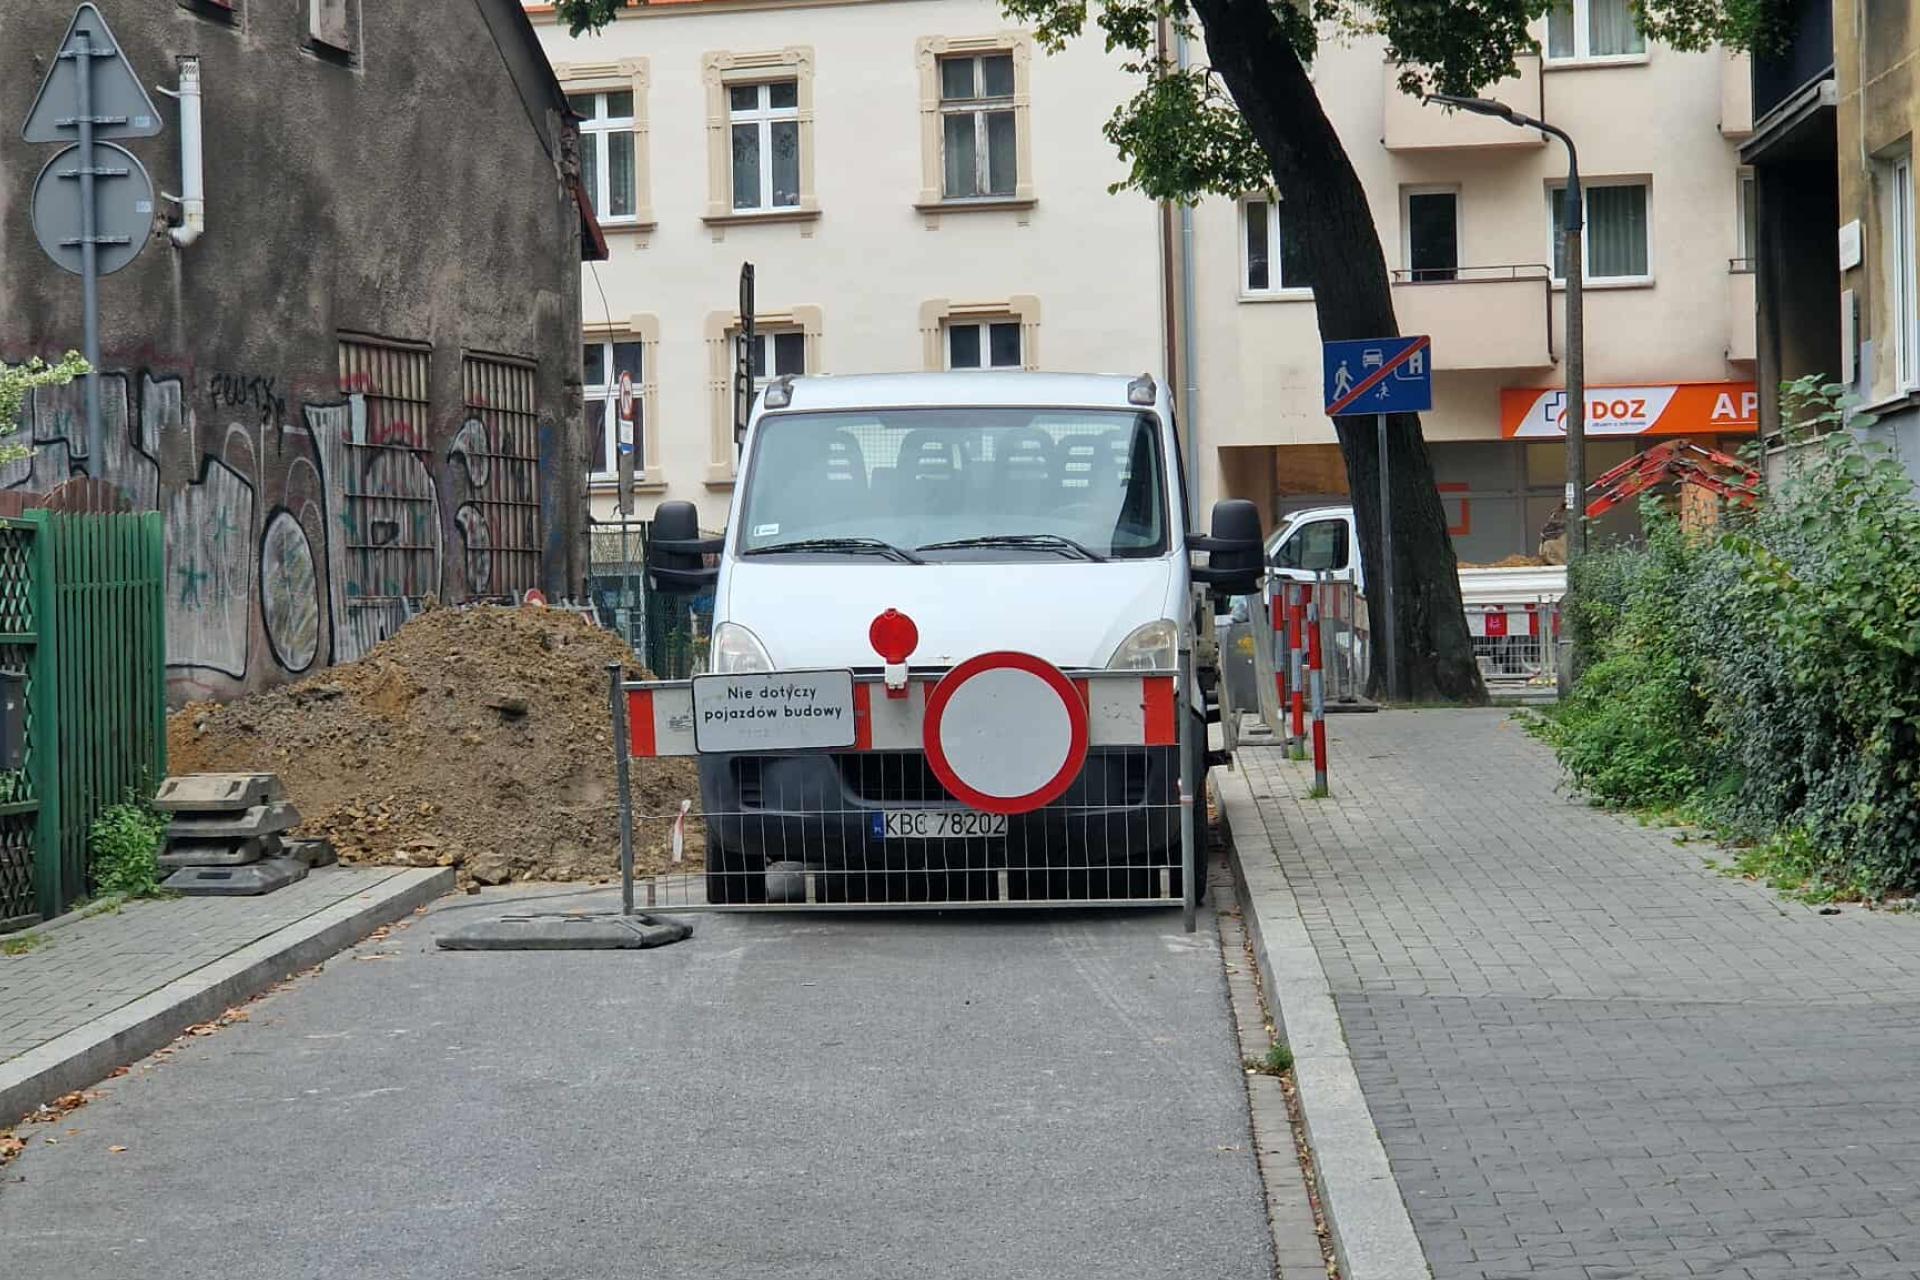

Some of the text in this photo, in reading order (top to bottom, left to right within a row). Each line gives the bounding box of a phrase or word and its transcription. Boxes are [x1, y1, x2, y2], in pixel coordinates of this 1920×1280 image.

[1592, 399, 1646, 419] DOZ
[727, 686, 817, 700] Nie dotyczy
[704, 705, 842, 723] pojazdów budowy
[936, 813, 1006, 835] 78202
